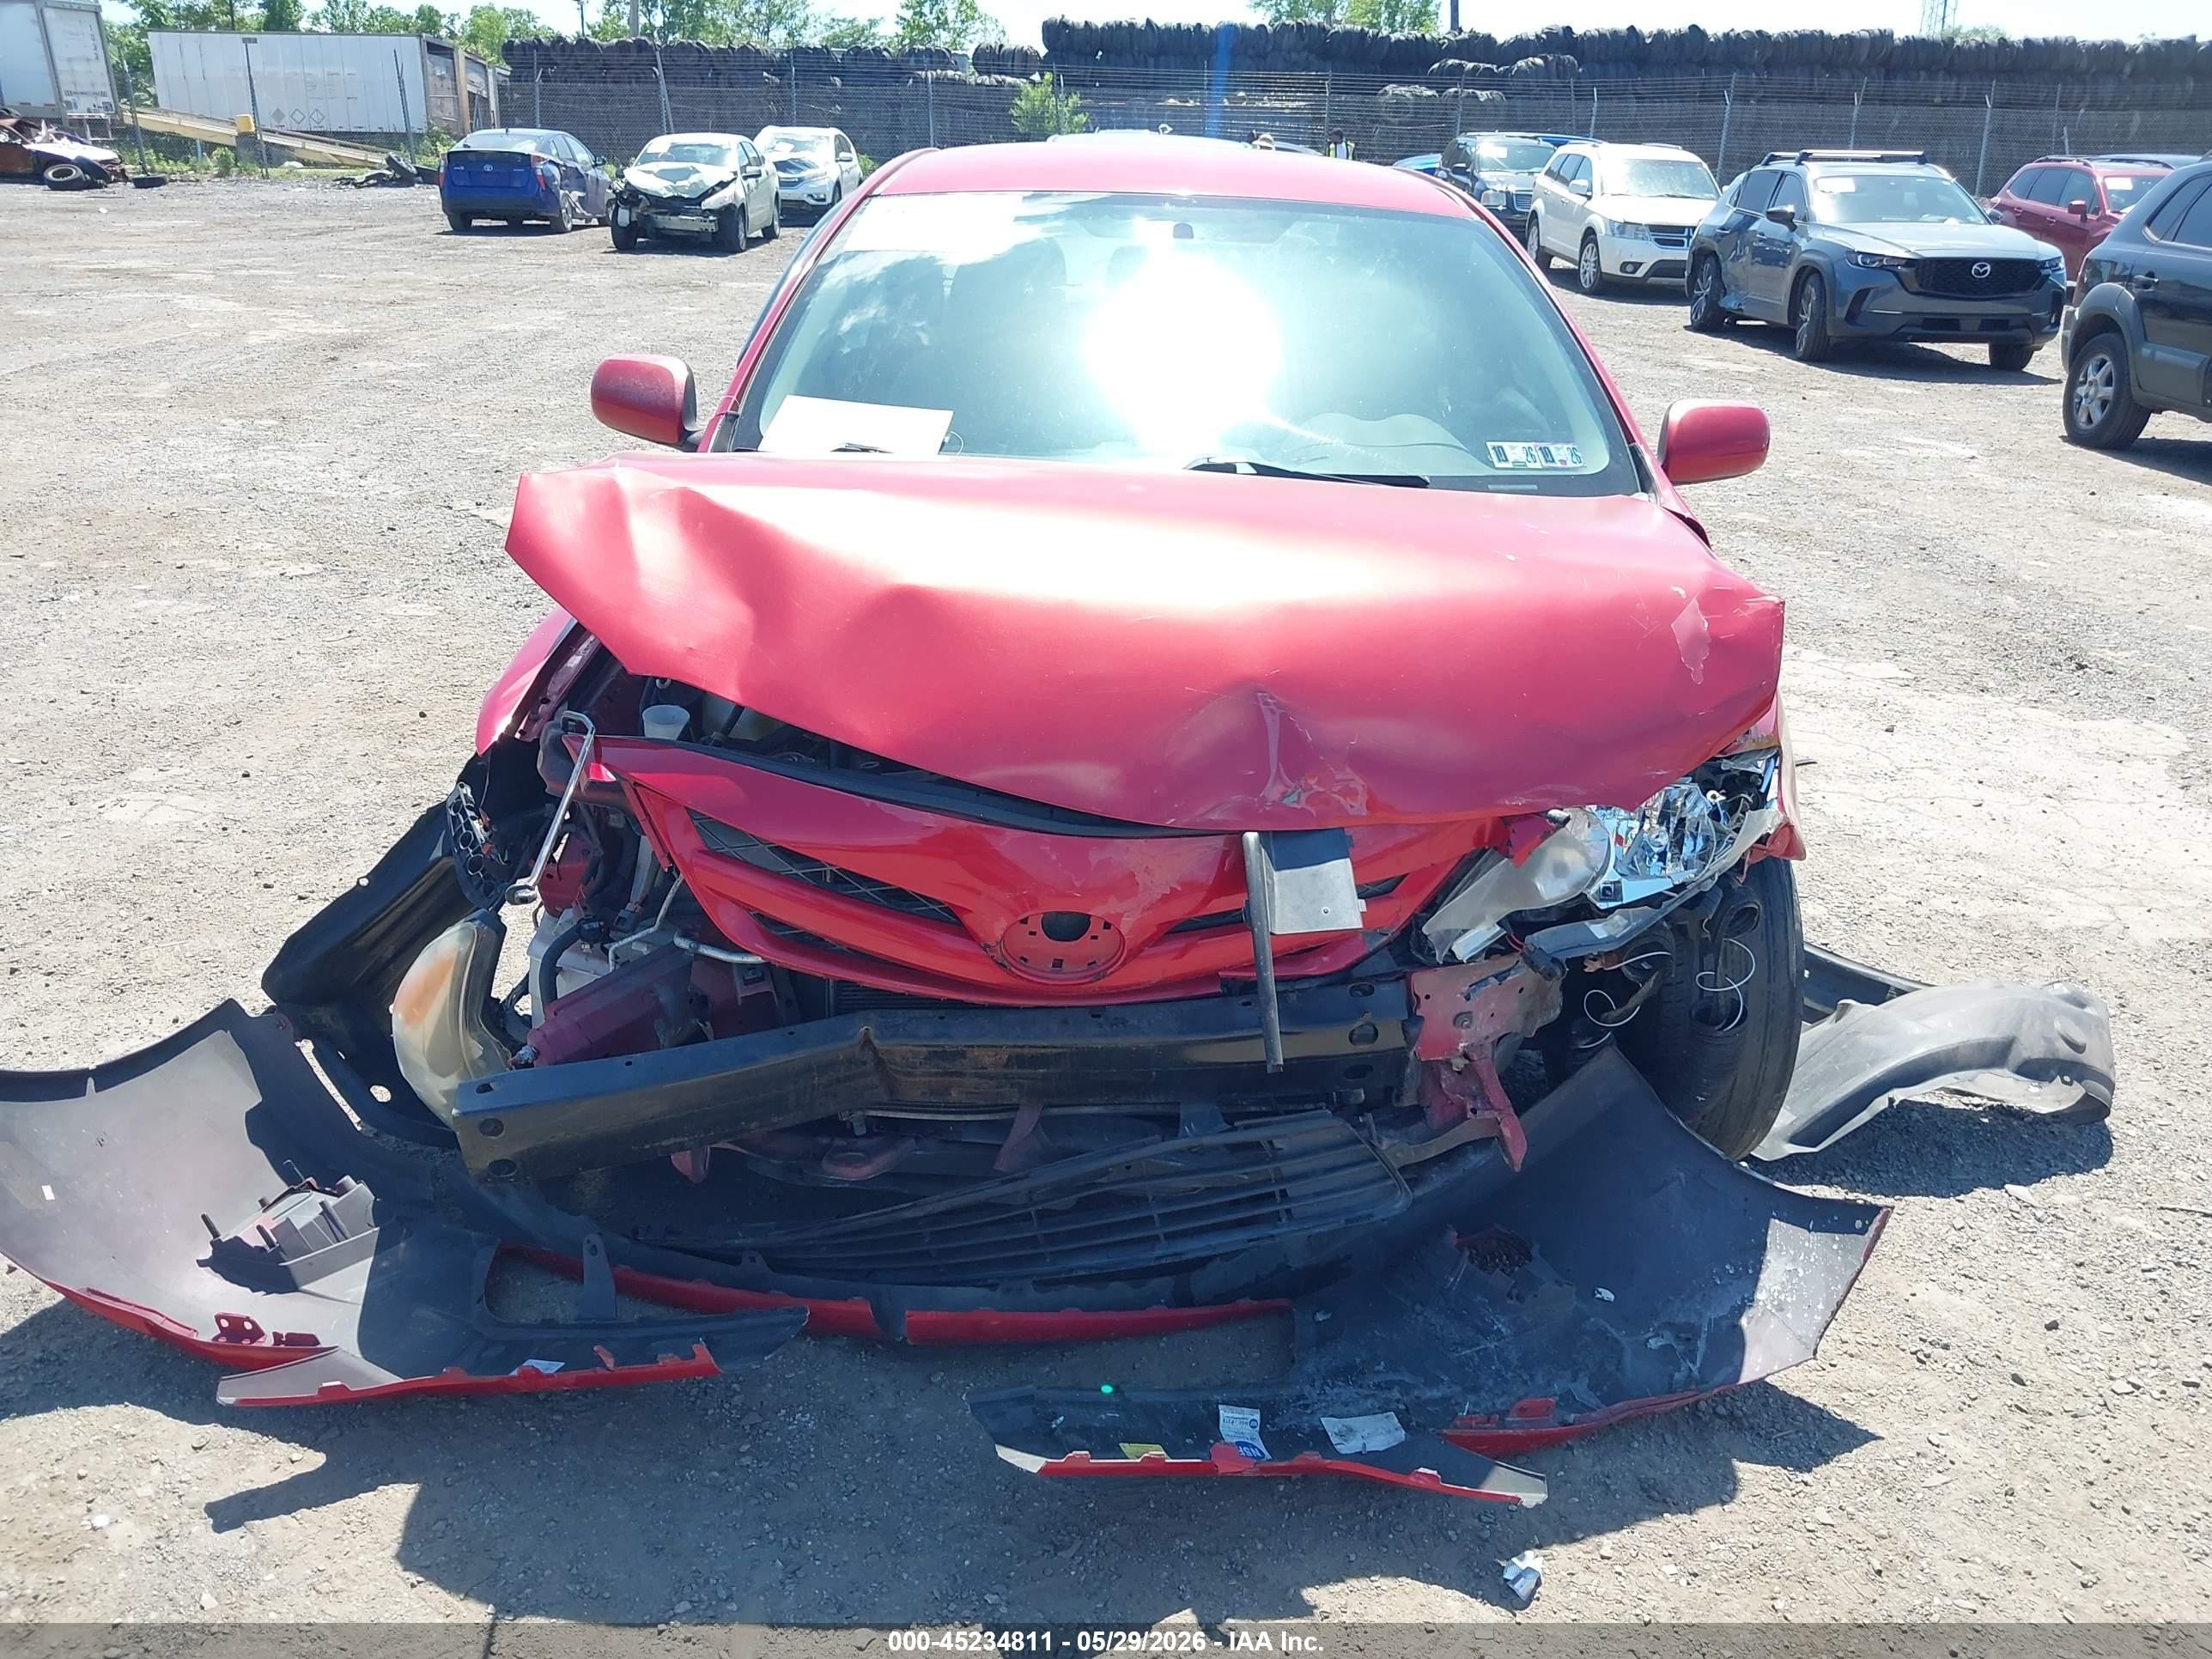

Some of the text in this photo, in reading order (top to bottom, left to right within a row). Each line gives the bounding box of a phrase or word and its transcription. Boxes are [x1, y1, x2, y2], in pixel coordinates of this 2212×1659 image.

[1492, 445, 1537, 463] 10 26
[1538, 446, 1582, 464] 10 26
[1238, 1445, 1262, 1457] NSF
